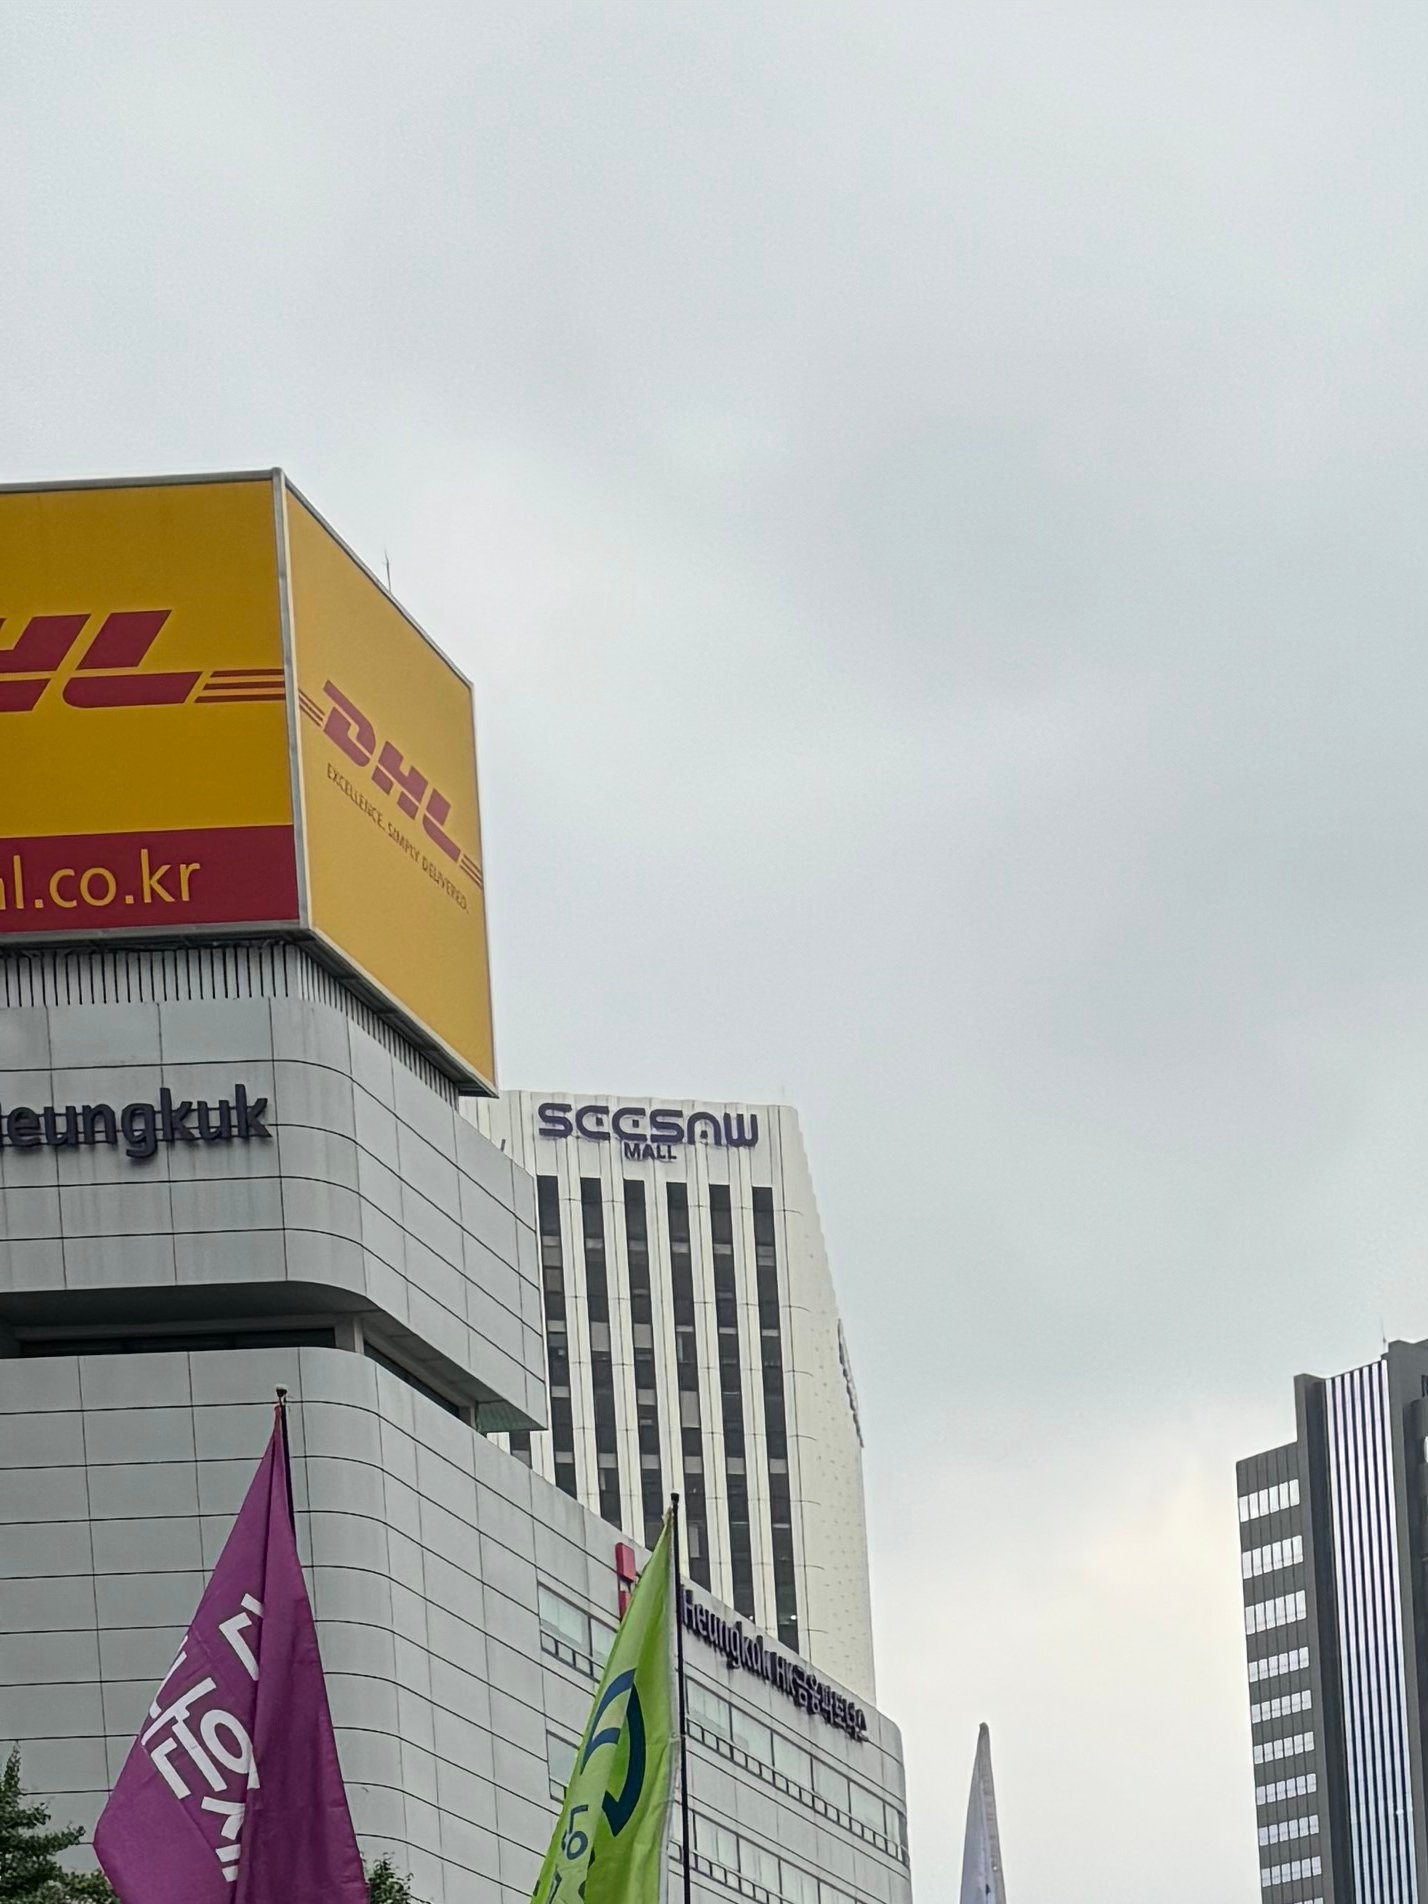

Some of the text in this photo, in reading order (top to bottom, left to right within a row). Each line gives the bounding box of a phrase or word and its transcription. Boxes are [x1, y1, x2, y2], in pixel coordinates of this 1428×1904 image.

[0, 610, 203, 712] HL
[323, 680, 461, 863] DHL
[2, 1084, 272, 1158] eungkuk
[624, 1142, 678, 1162] MALL
